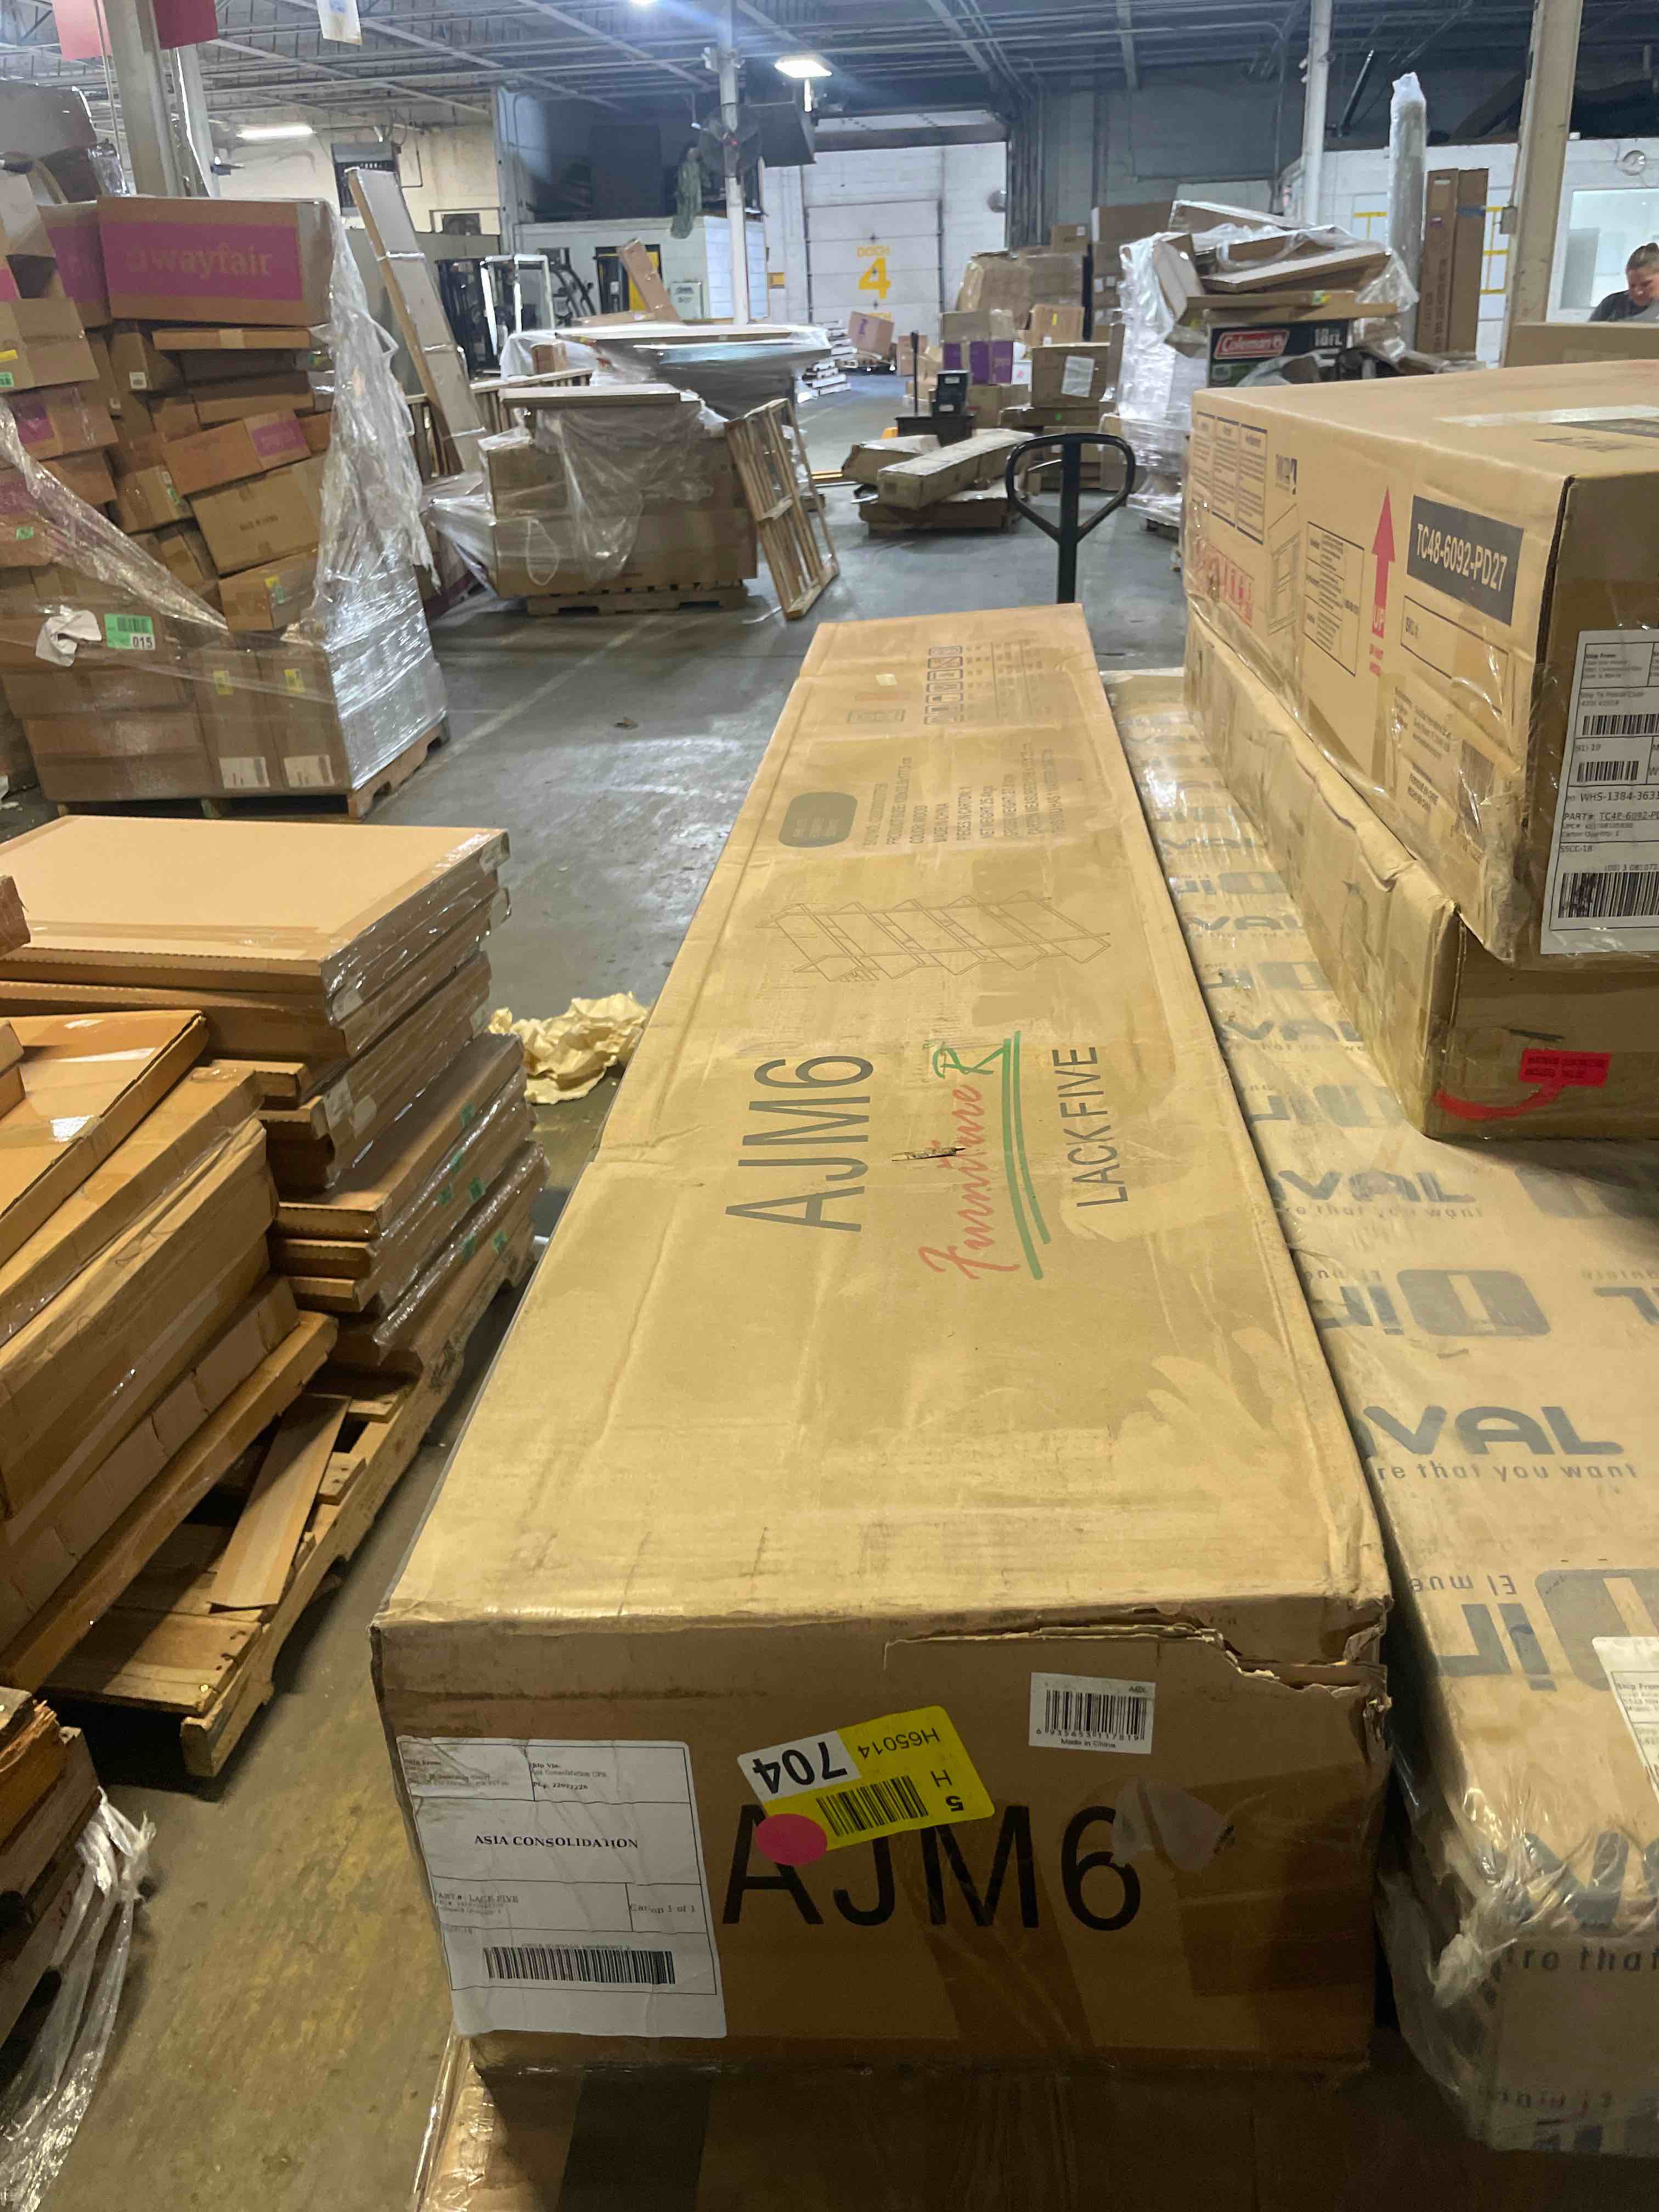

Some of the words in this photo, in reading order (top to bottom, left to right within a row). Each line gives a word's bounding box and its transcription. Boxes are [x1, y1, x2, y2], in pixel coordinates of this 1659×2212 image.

[859, 258, 891, 300] 4
[1418, 522, 1508, 592] TC48-6092-PD27
[132, 635, 153, 649] 015
[1051, 1046, 1109, 1118] FIVE
[725, 1054, 874, 1233] AJM6
[1065, 1124, 1129, 1208] LACK
[1274, 1170, 1476, 1203] VAL
[1359, 1405, 1624, 1457] VAL
[1417, 1460, 1480, 1479] that
[1493, 1465, 1548, 1483] you
[1562, 1462, 1638, 1479] want
[1408, 1575, 1472, 1593] mue
[857, 1726, 939, 1760] H65014
[752, 1741, 848, 1795] 704
[930, 1769, 953, 1789] H
[944, 1795, 964, 1812] 5
[475, 1835, 509, 1845] ASIA
[512, 1836, 639, 1849] CONSOLIDATION
[722, 1804, 1141, 1932] AJM6
[676, 1904, 689, 1913] of
